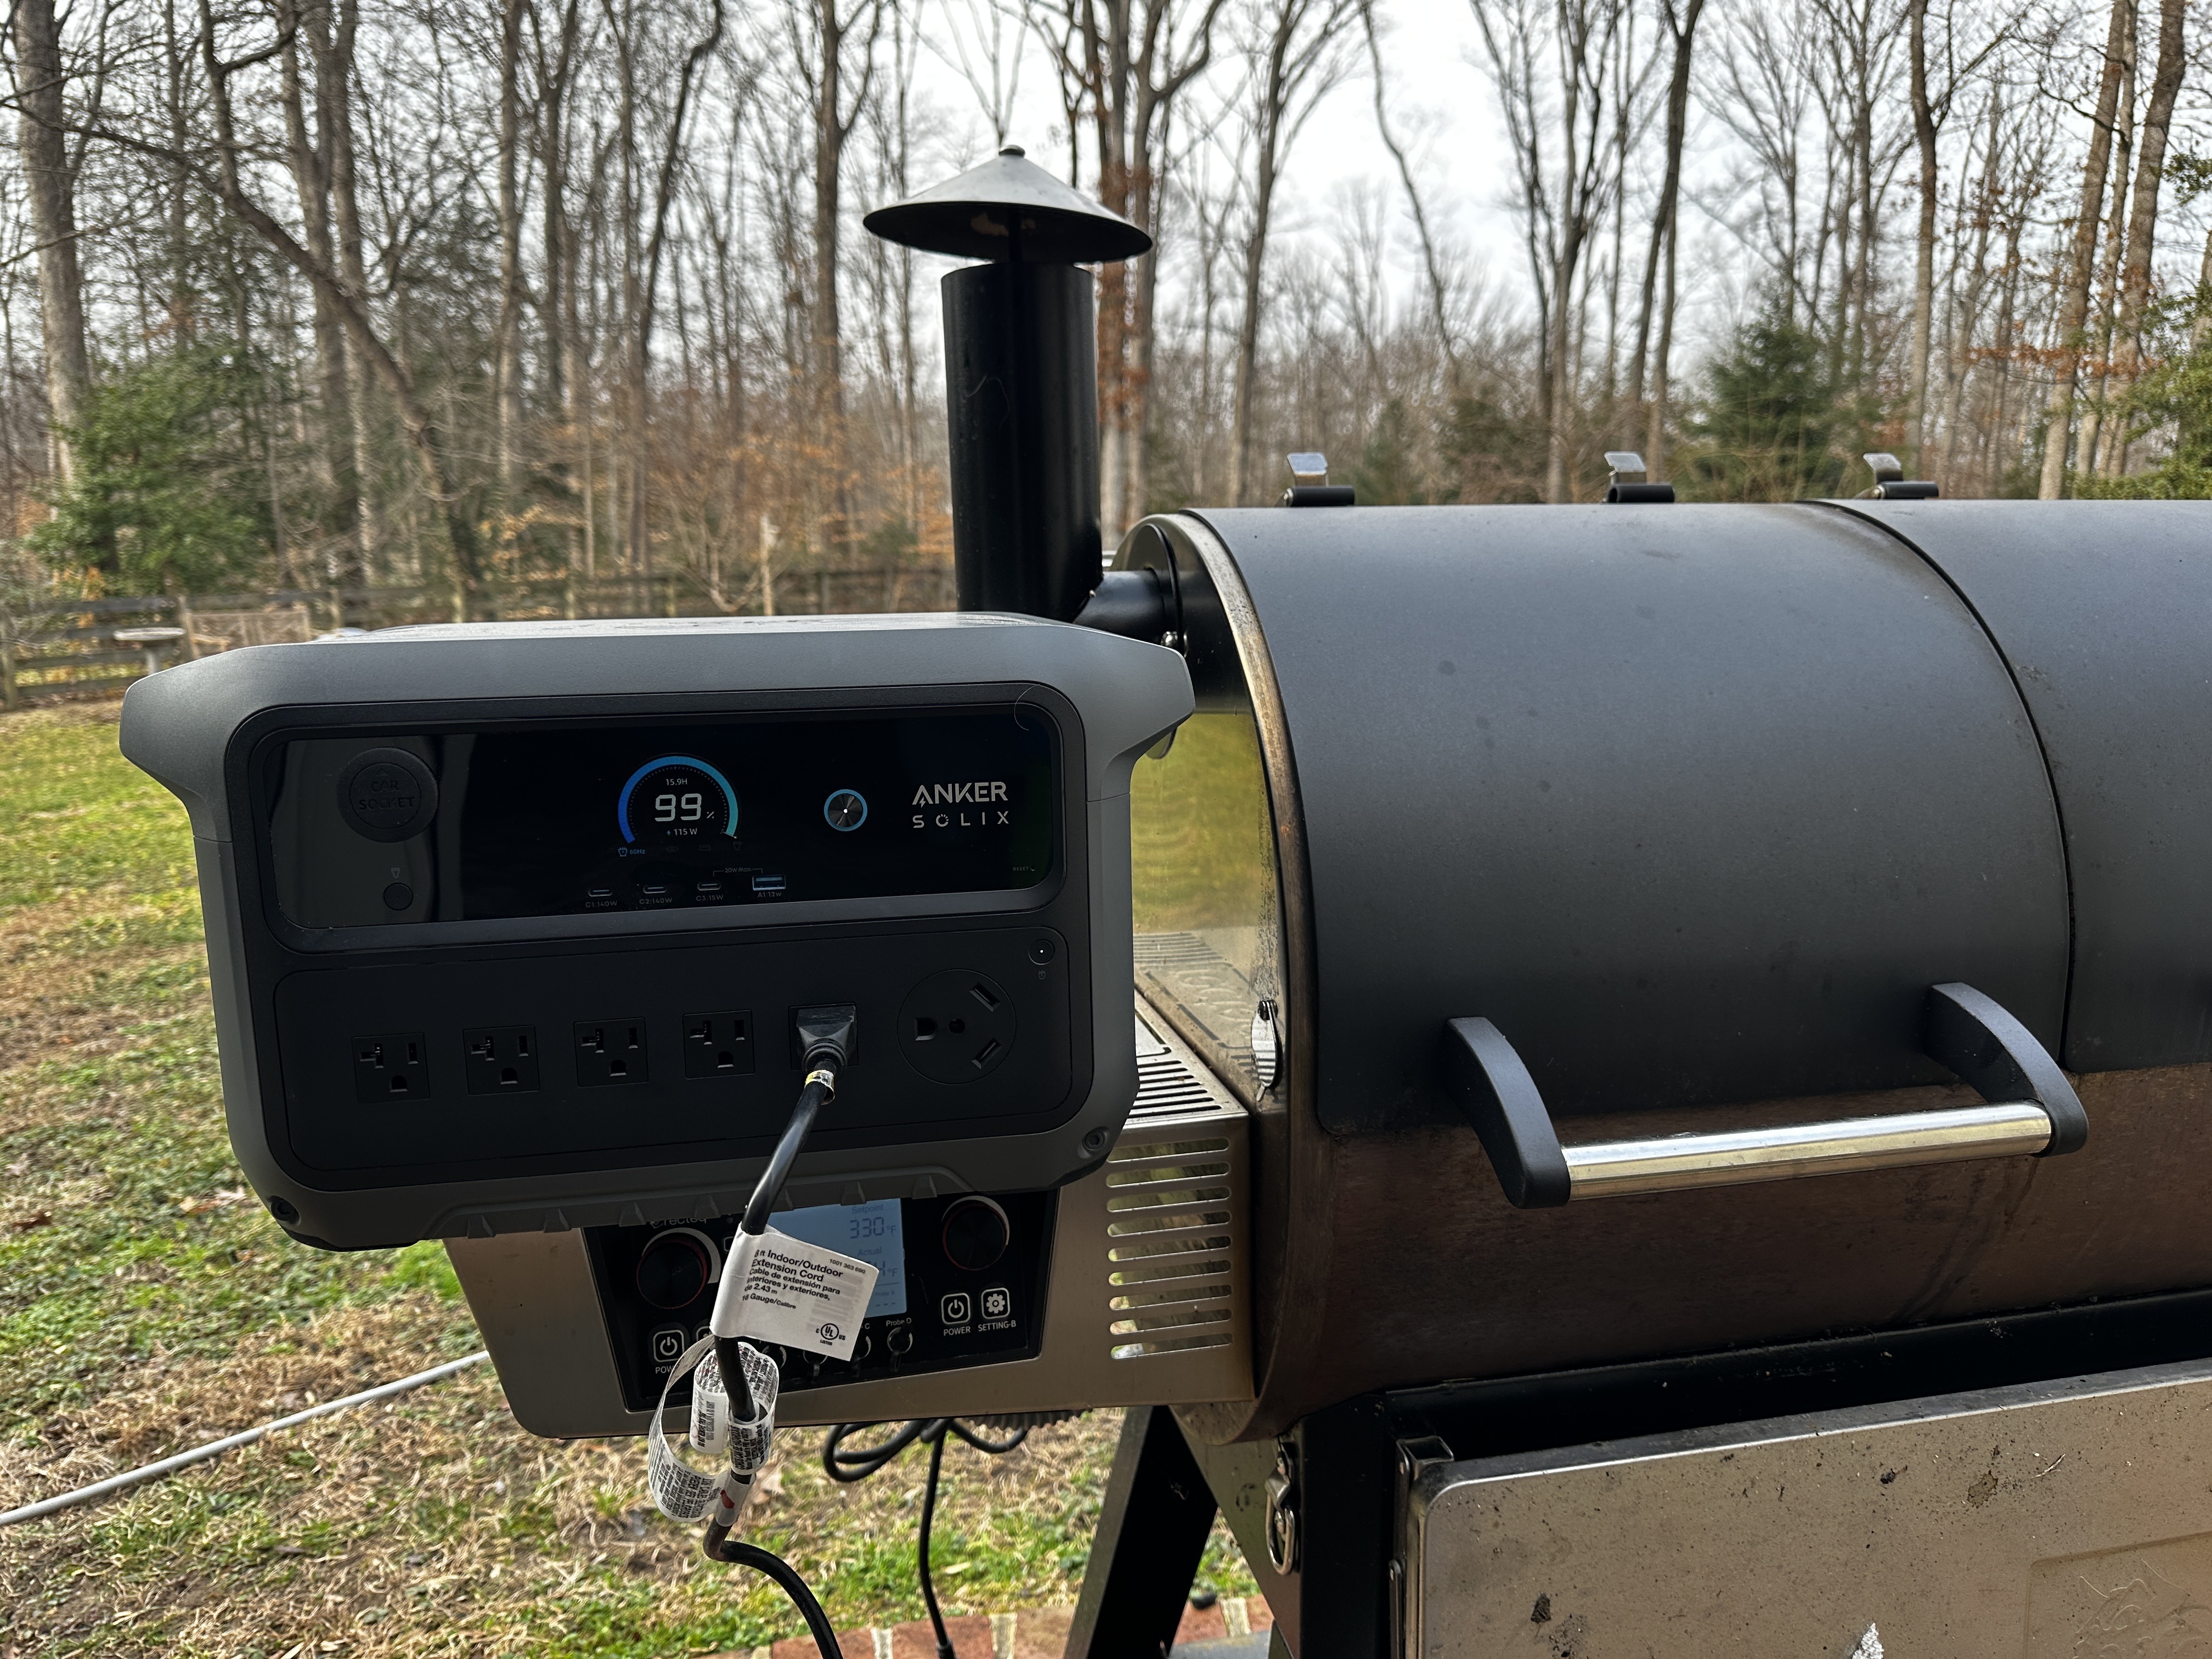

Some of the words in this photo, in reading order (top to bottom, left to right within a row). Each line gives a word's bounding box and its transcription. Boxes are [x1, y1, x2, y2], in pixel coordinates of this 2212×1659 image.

[370, 781, 399, 792] CAR
[912, 781, 1008, 808] ANKER
[359, 797, 415, 810] SOCKET
[912, 811, 1009, 828] SOLIX
[851, 1204, 883, 1214] Setpoint
[857, 1247, 882, 1256] Actual
[768, 1250, 843, 1277] Indoor/Outdoor
[751, 1259, 797, 1276] Extension
[799, 1269, 824, 1282] Cord
[749, 1267, 769, 1276] Cable
[783, 1276, 821, 1289] extensión
[822, 1285, 840, 1295] para
[753, 1283, 771, 1293] 2.43
[789, 1285, 830, 1301] exteriores,
[750, 1293, 797, 1309] Gauge/Calibre
[943, 1326, 971, 1336] POWER
[978, 1320, 1017, 1331] SETTING-B
[655, 1365, 673, 1374] POW
